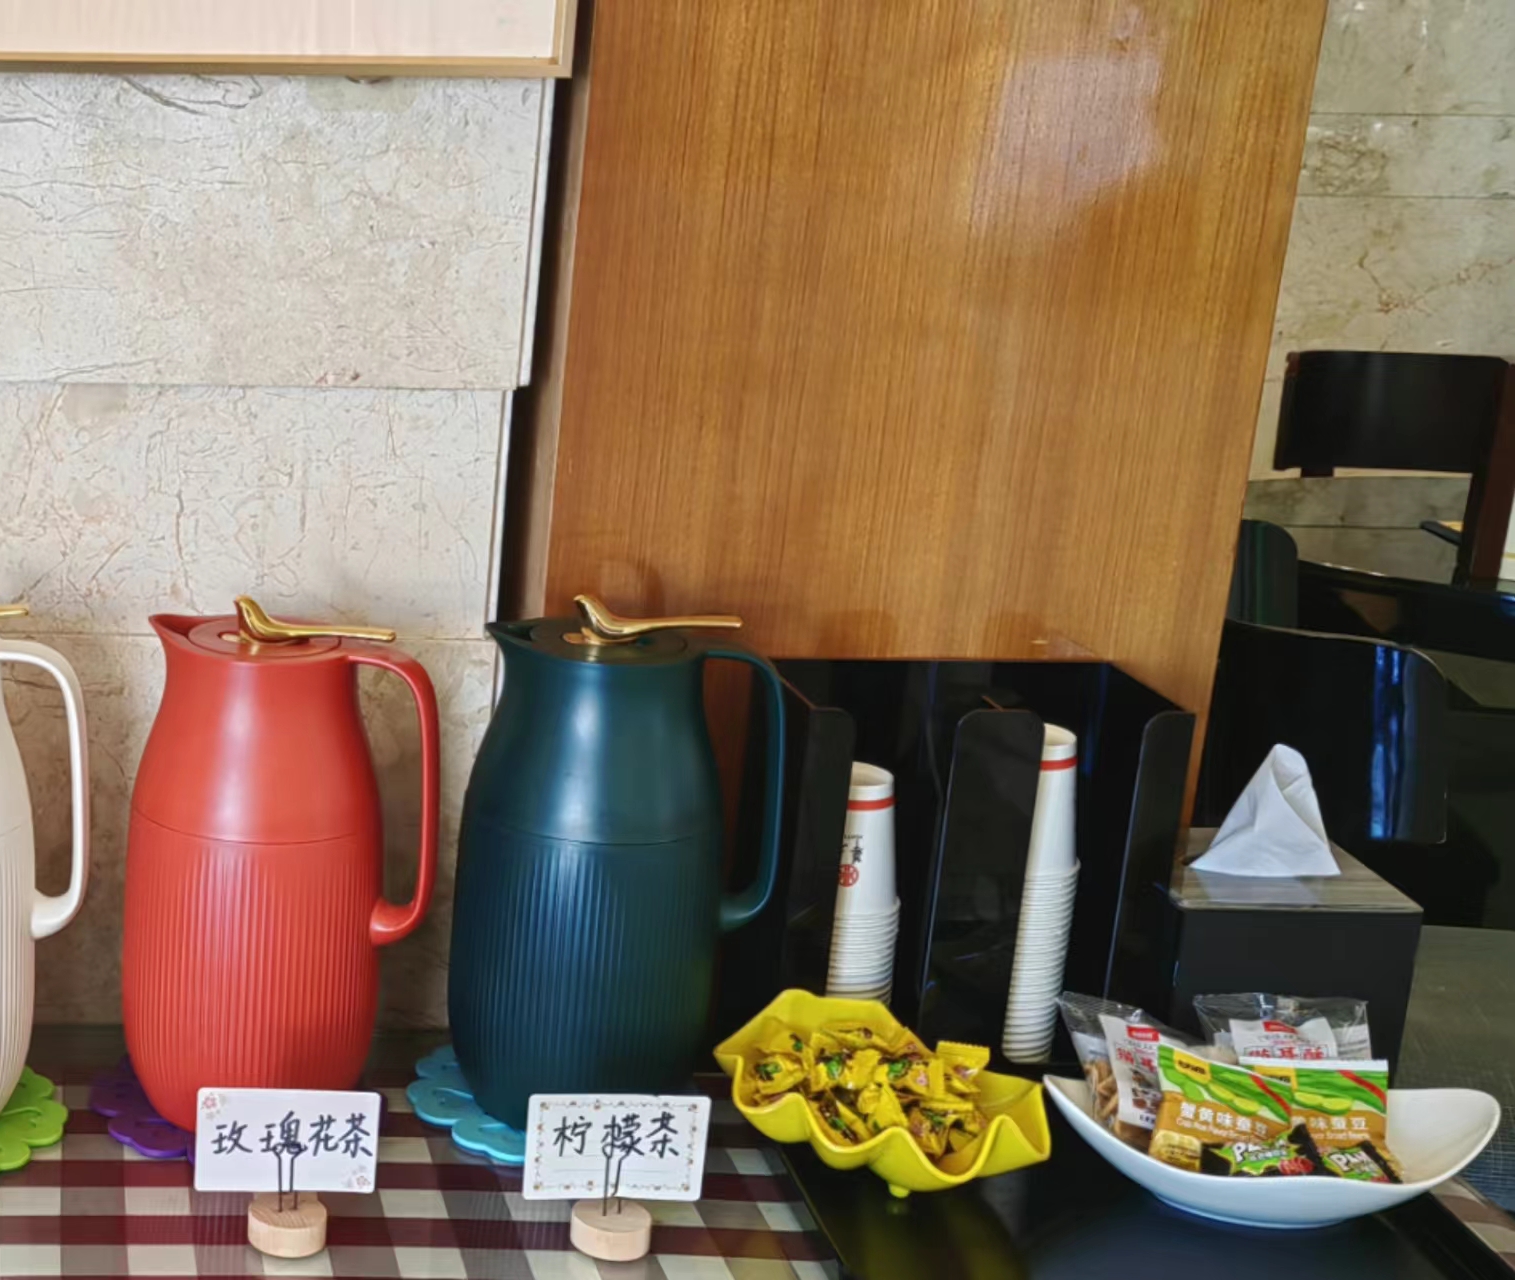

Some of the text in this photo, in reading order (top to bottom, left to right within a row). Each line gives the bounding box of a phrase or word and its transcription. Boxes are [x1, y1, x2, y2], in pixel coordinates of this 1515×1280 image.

[211, 1110, 373, 1158] 玫瑰花茶
[553, 1111, 680, 1159] 柠檬茶
